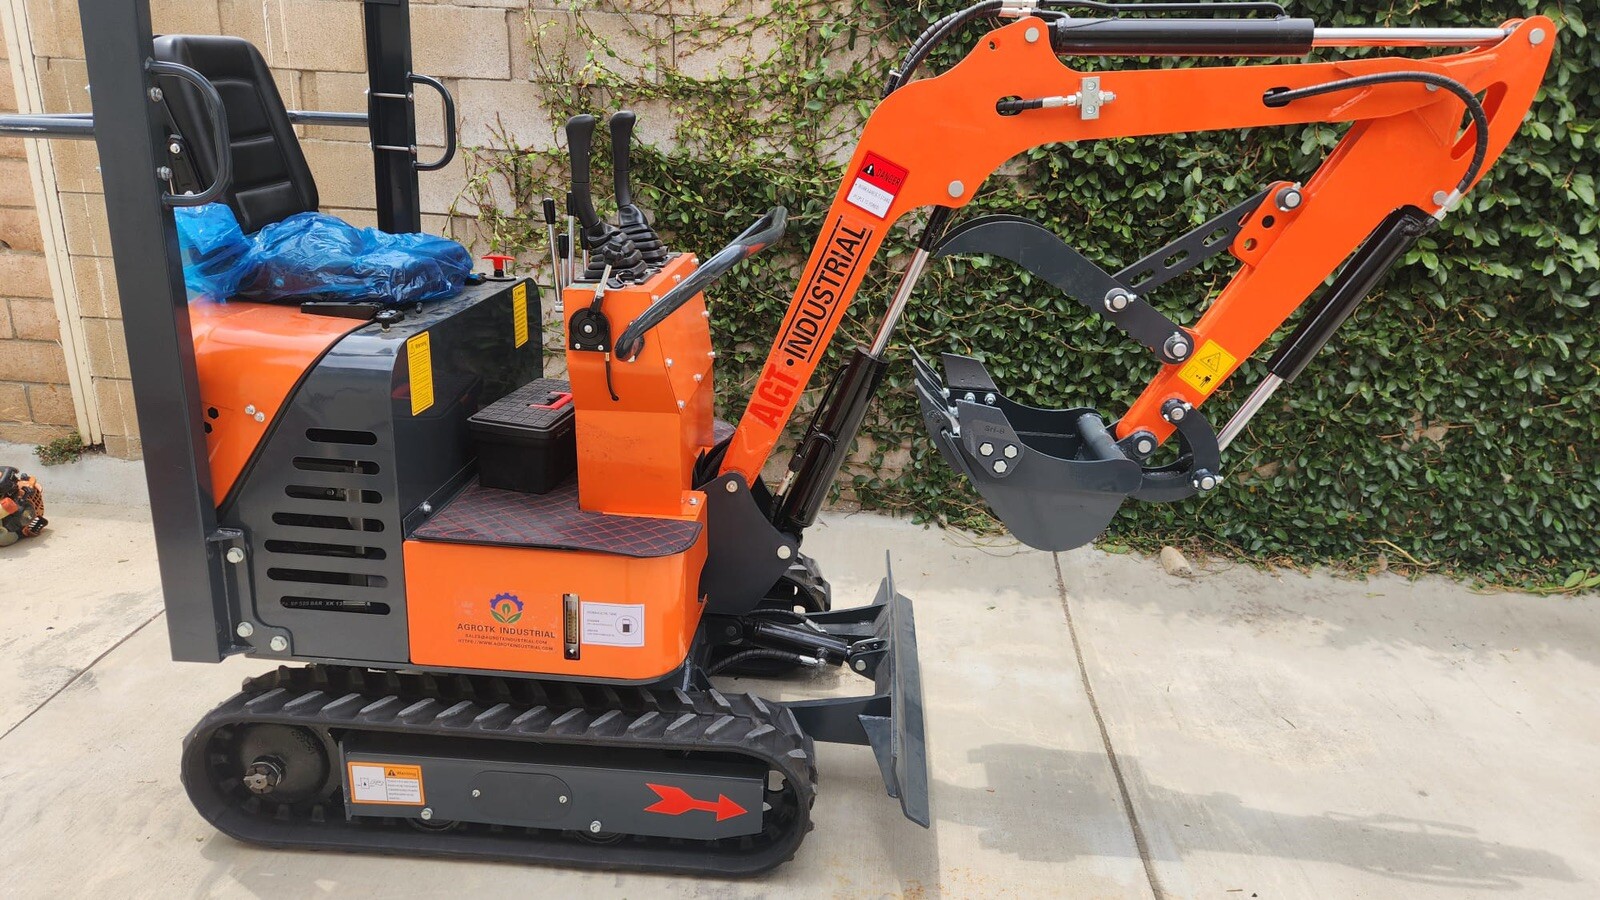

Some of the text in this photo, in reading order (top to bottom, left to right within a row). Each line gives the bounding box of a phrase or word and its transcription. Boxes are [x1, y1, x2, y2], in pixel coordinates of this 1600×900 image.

[876, 168, 901, 186] DANGER
[749, 363, 799, 430] AGT
[784, 226, 867, 360] INDUSTRIAL
[457, 623, 555, 638] AGROTK INDUSTRIAL
